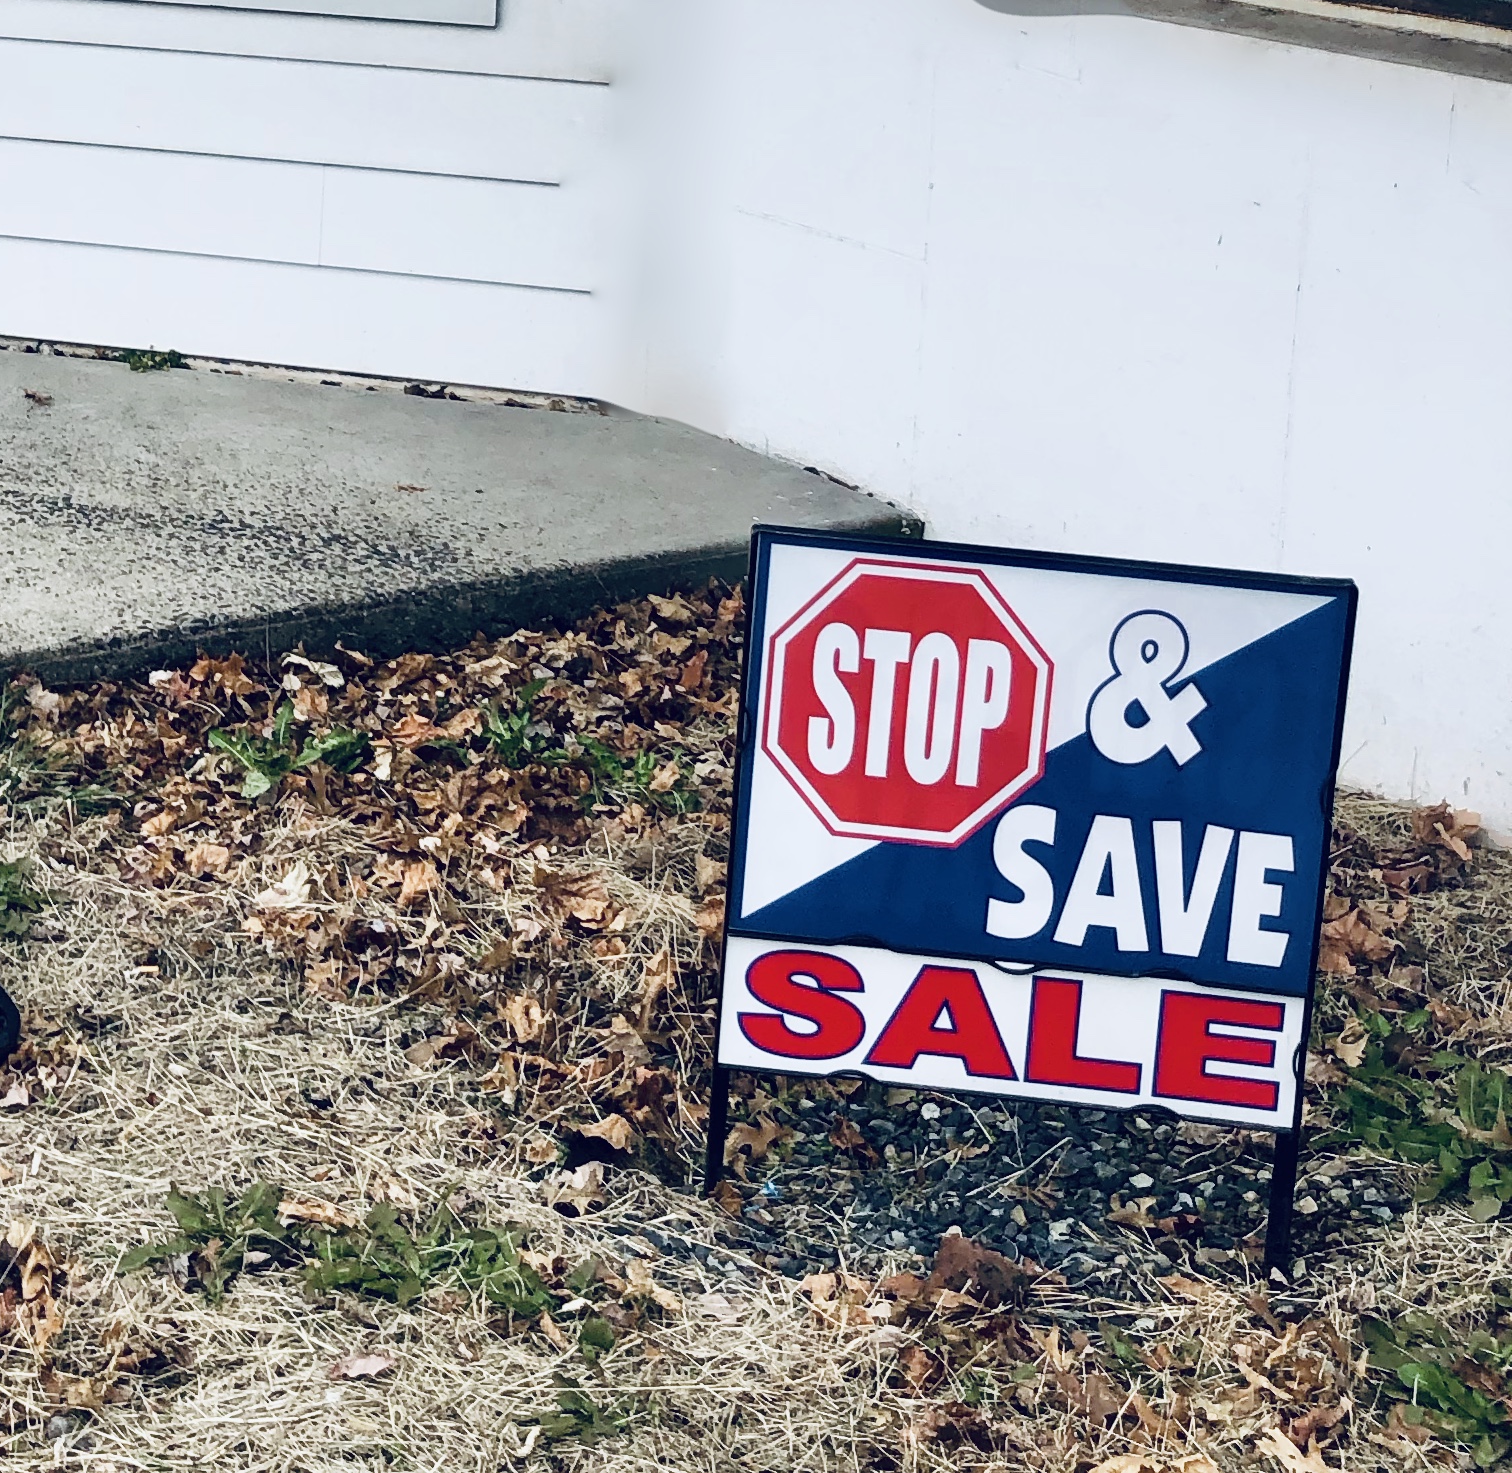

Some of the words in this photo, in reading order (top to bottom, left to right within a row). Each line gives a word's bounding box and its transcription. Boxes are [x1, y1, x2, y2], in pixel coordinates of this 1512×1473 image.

[806, 621, 1013, 788] STOP
[1086, 608, 1209, 771] &
[985, 803, 1296, 969] SAVE
[736, 948, 1286, 1113] SALE
